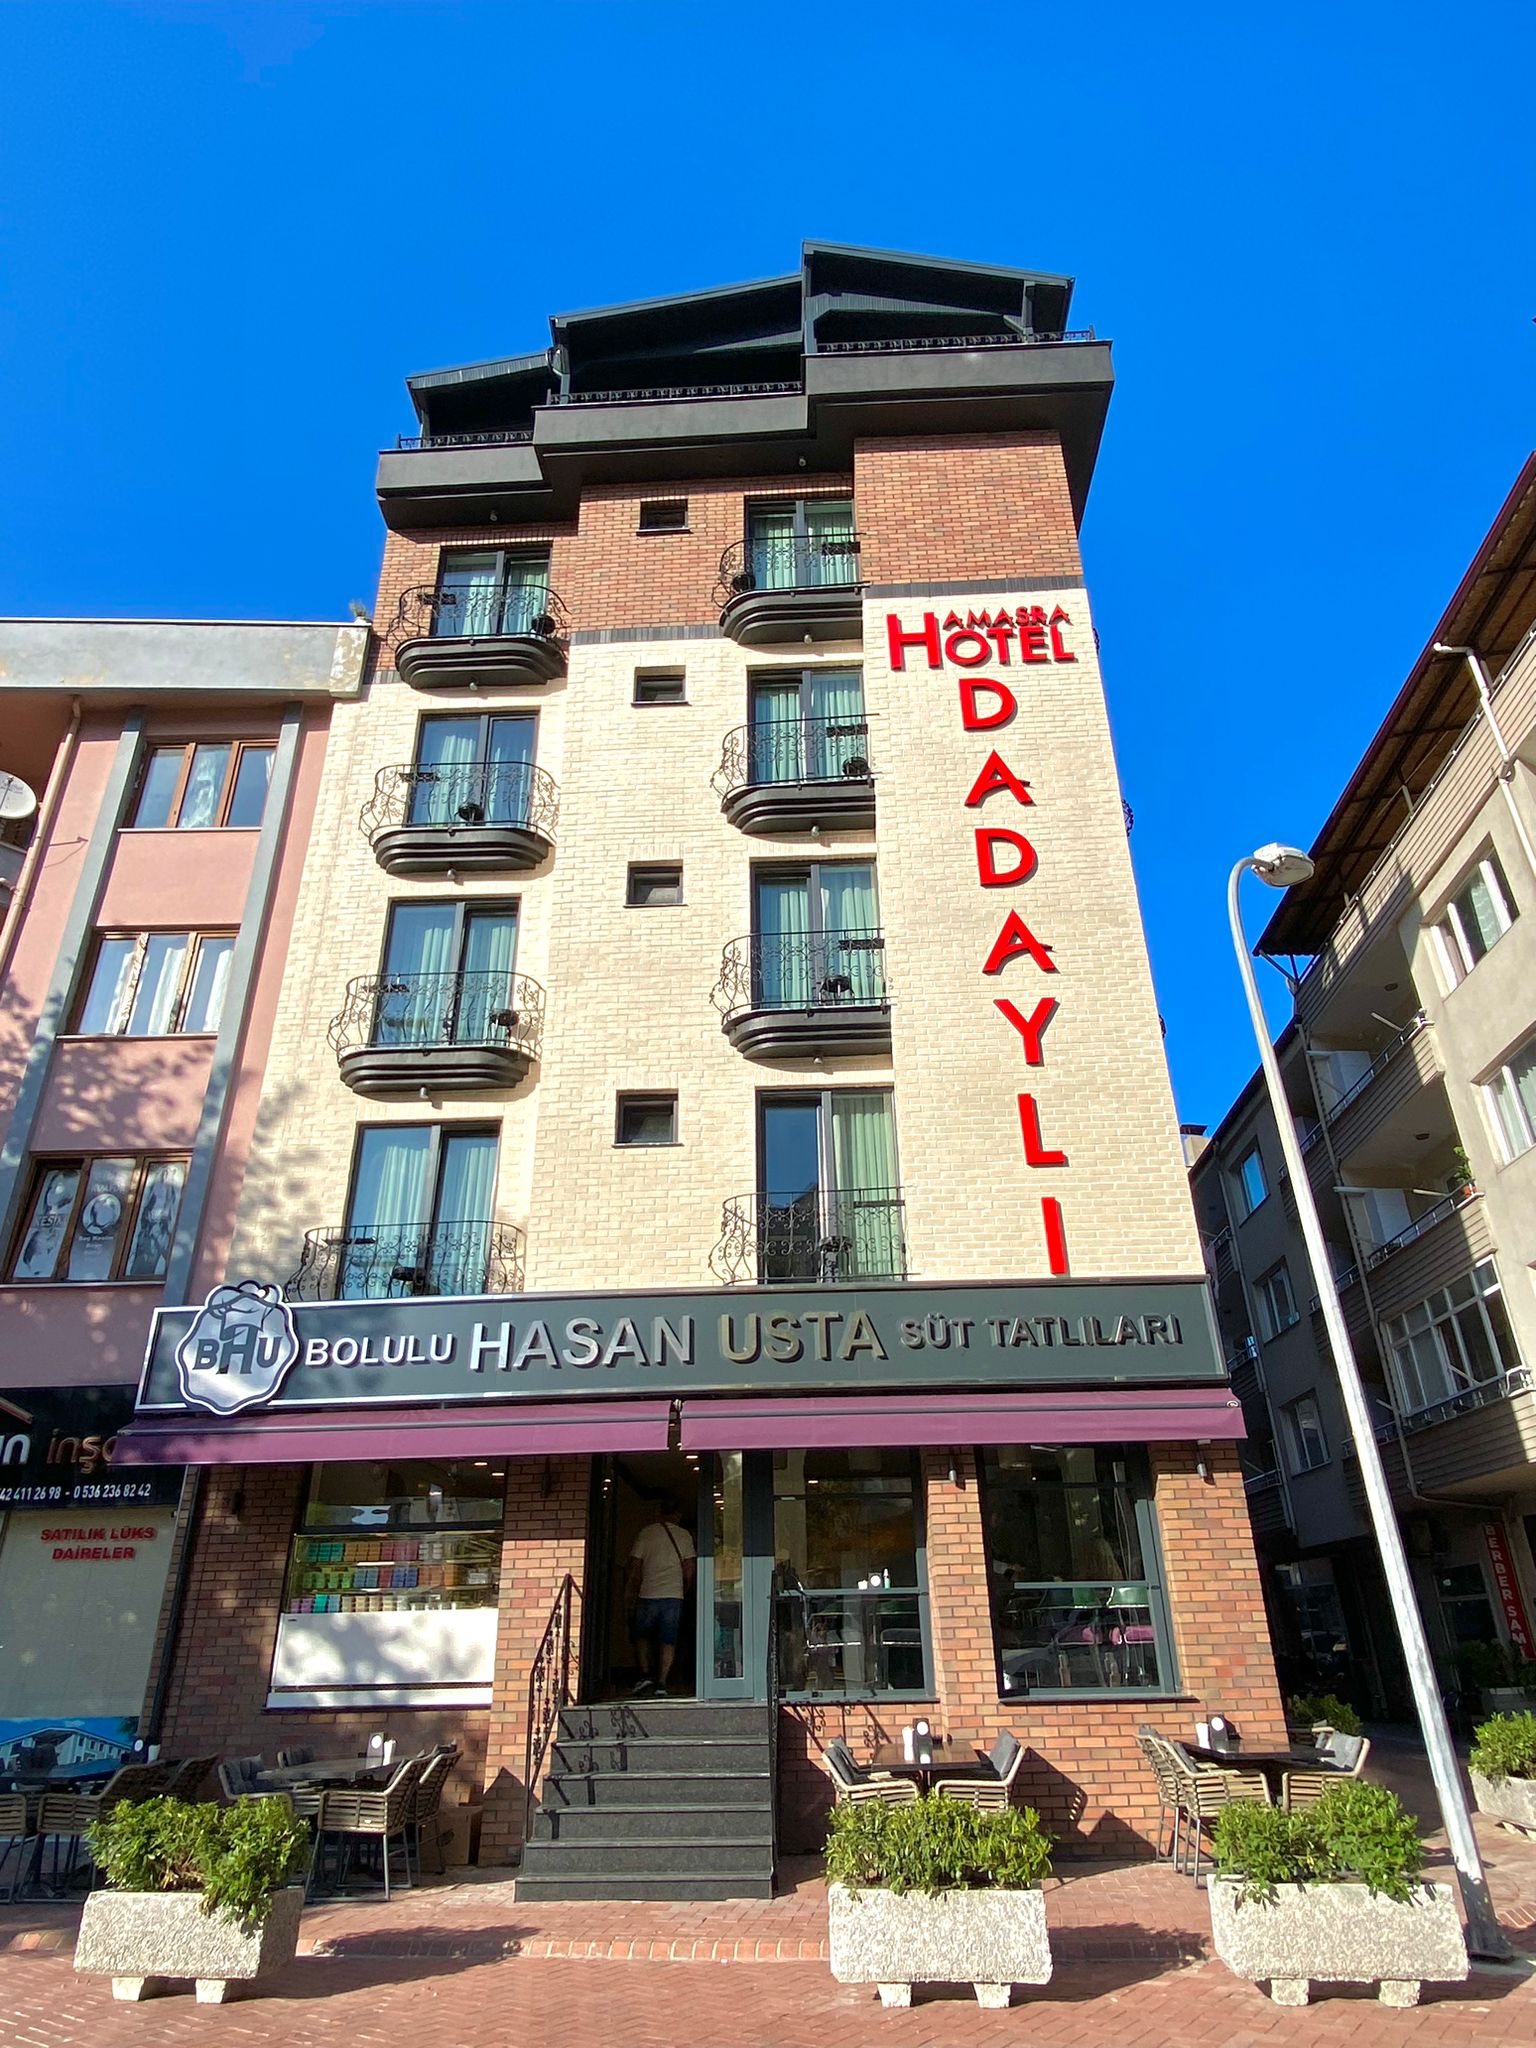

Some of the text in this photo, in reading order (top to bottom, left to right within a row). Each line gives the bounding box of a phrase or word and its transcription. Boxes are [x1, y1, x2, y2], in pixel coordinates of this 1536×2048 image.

[943, 604, 1073, 628] AMASRA
[886, 611, 1076, 671] HOTEL
[958, 678, 1069, 1278] DADAYLI
[192, 1324, 284, 1375] BHU
[304, 1310, 1183, 1372] BOLULU HASAN USTA SÜT TATLILARI
[0, 1433, 31, 1465] n
[13, 1486, 32, 1500] 411
[33, 1486, 46, 1500] 26
[48, 1485, 61, 1500] 98
[73, 1485, 80, 1498] 0
[82, 1484, 101, 1499] 536
[102, 1483, 121, 1498] 236
[123, 1483, 136, 1497] 82
[137, 1482, 151, 1497] 42
[41, 1526, 156, 1542] SATILIK LÜKS
[52, 1546, 136, 1560] DAİRELER
[1484, 1524, 1514, 1601] BERBER
